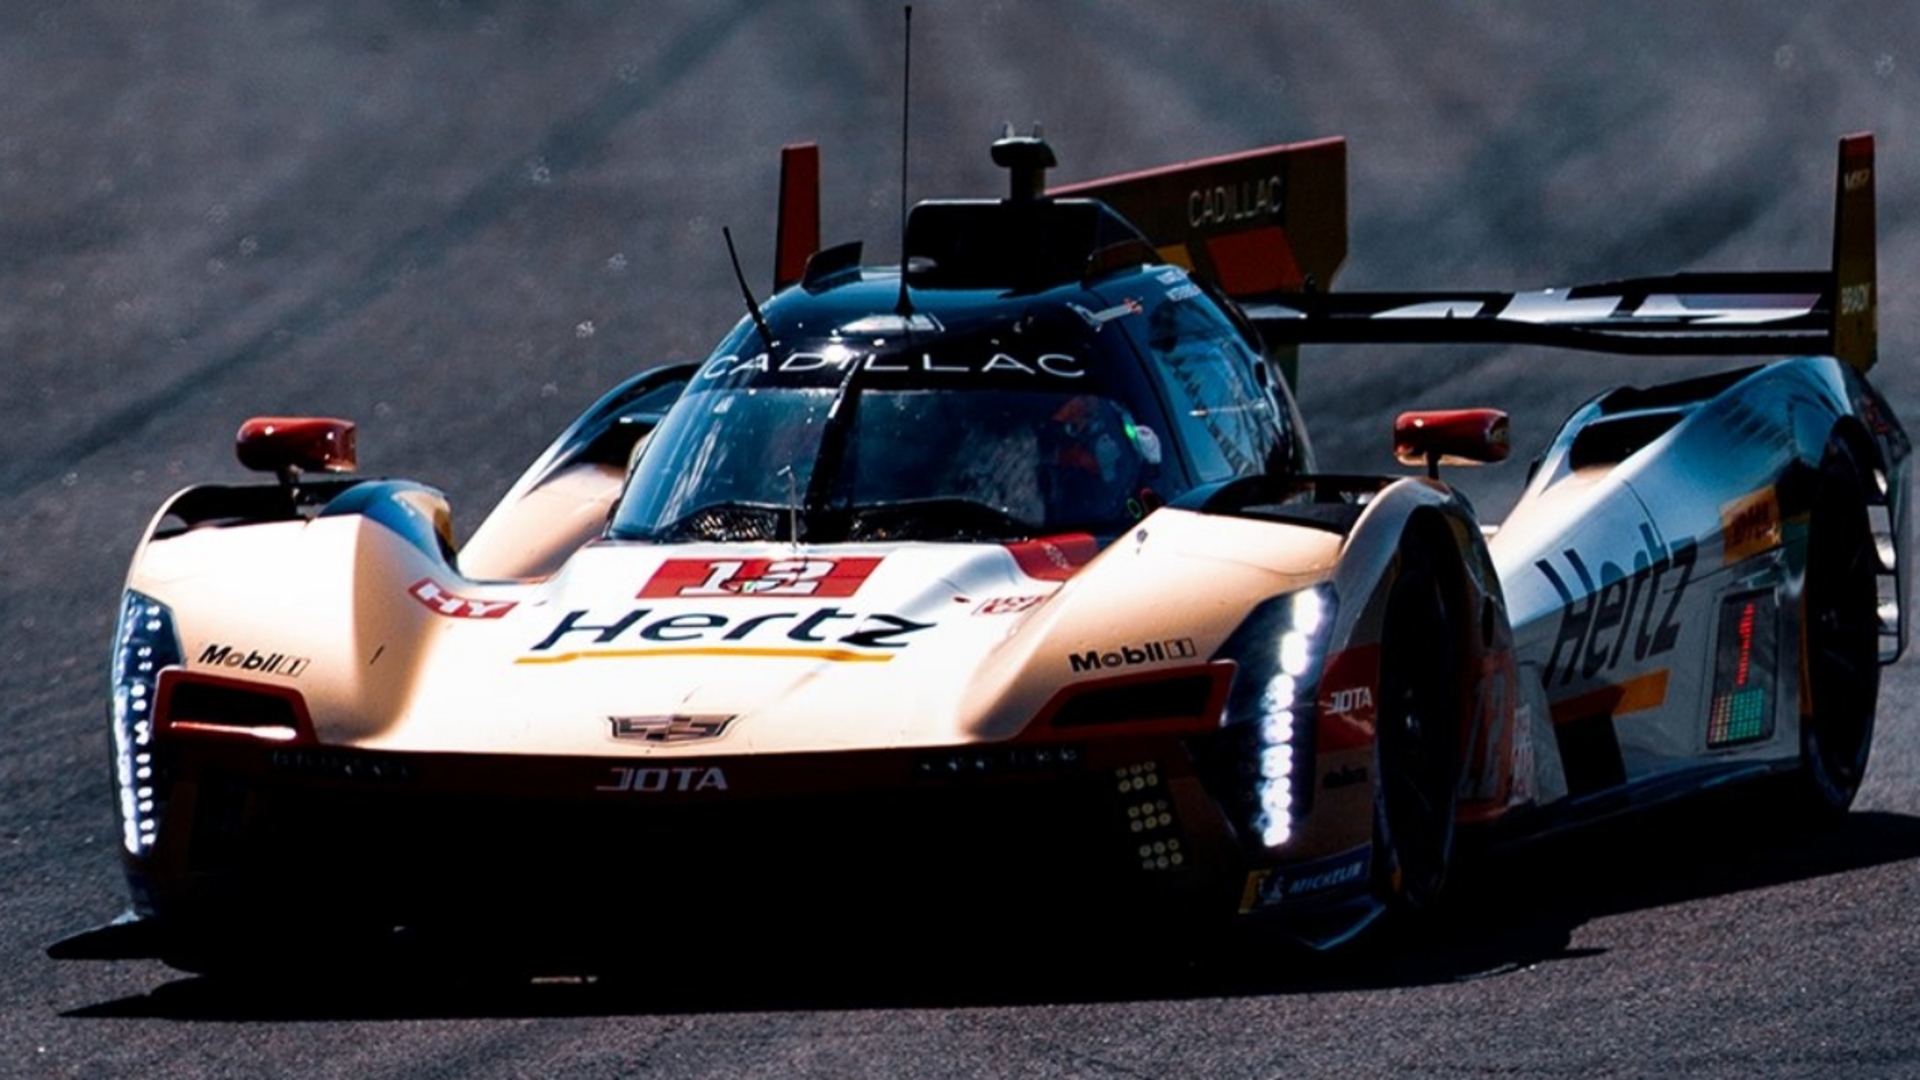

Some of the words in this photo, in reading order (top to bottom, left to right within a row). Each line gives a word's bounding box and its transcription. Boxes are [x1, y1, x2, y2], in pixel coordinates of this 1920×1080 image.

[1188, 175, 1282, 228] CADILLAC
[703, 352, 1086, 380] CADILLAC
[679, 559, 839, 597] 12
[1534, 522, 1698, 690] Hertz
[530, 606, 939, 651] Hertz
[1323, 685, 1374, 715] JOTA
[595, 766, 728, 791] JOTA
